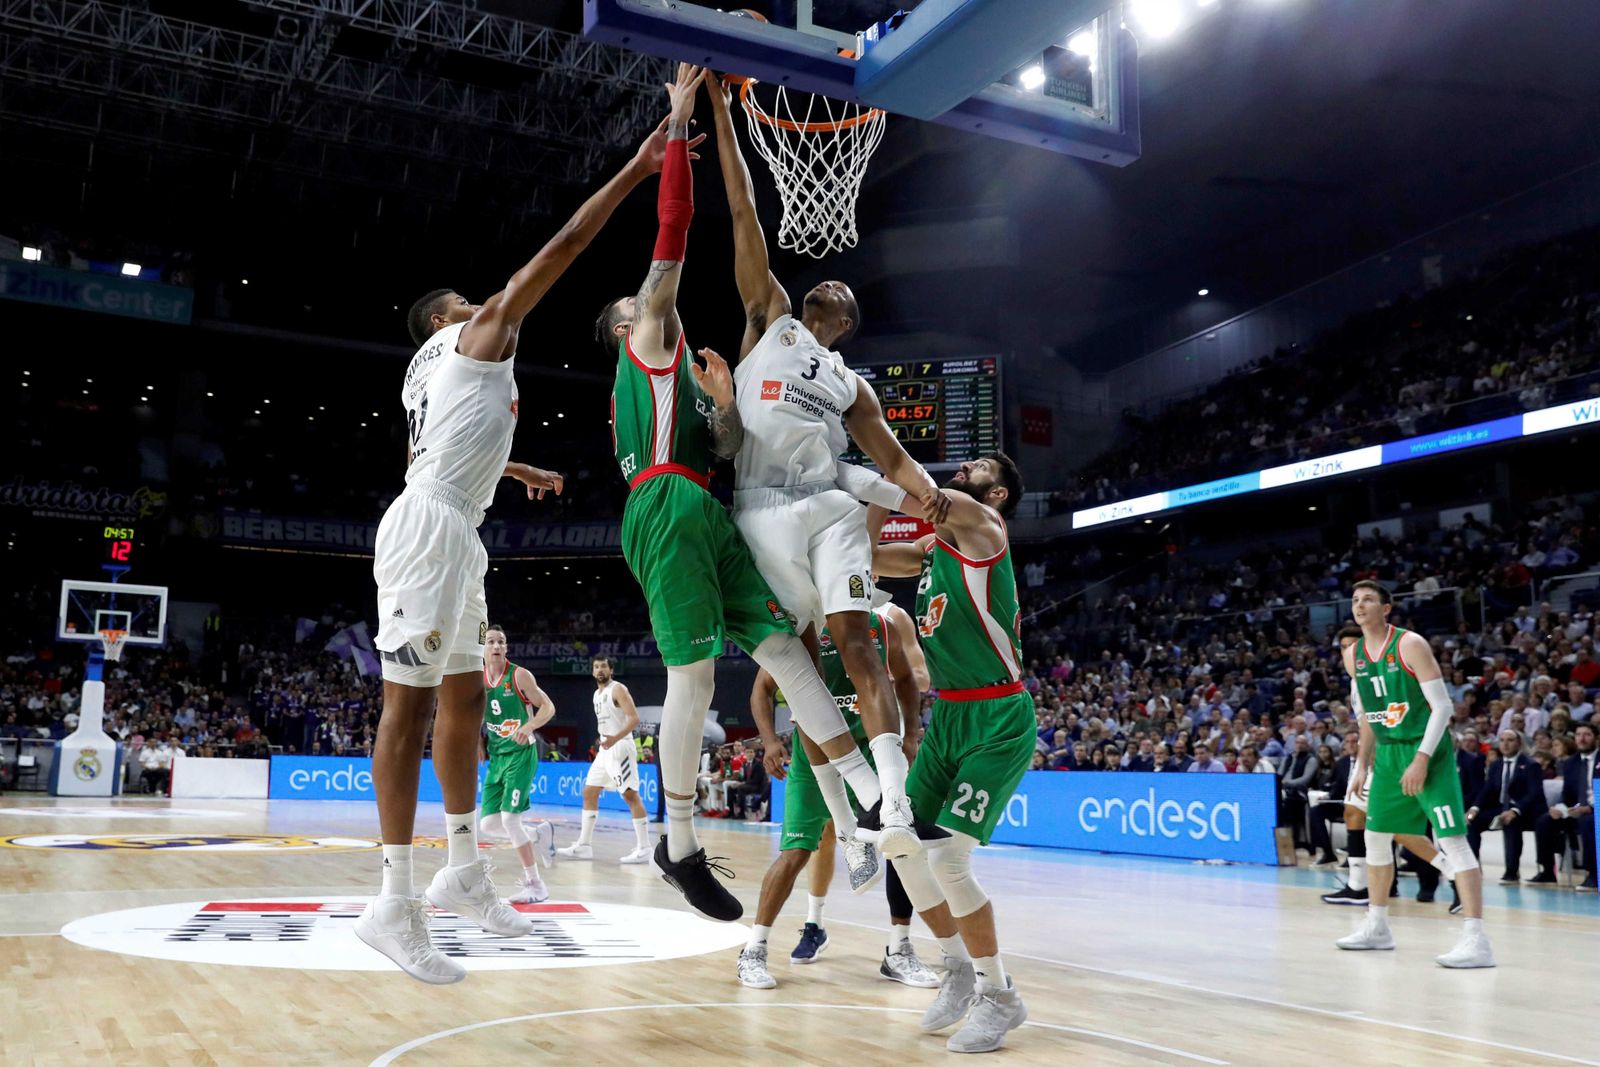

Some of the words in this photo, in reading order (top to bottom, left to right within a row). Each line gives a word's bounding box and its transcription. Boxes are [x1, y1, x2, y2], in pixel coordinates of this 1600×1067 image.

[800, 356, 821, 381] 3
[886, 365, 903, 377] 10
[921, 363, 932, 375] 7
[907, 386, 914, 397] 1
[784, 393, 825, 419] Europea
[886, 405, 934, 420] 04:57
[920, 427, 928, 438] 1
[104, 527, 134, 539] 04:57
[111, 540, 132, 561] 12
[690, 635, 716, 645] KELME
[1370, 675, 1388, 698] 11
[490, 699, 502, 716] 9
[289, 764, 373, 791] ende
[511, 788, 521, 808] 9
[950, 782, 990, 824] 23
[1078, 787, 1240, 842] endesa
[1432, 805, 1456, 830] 11
